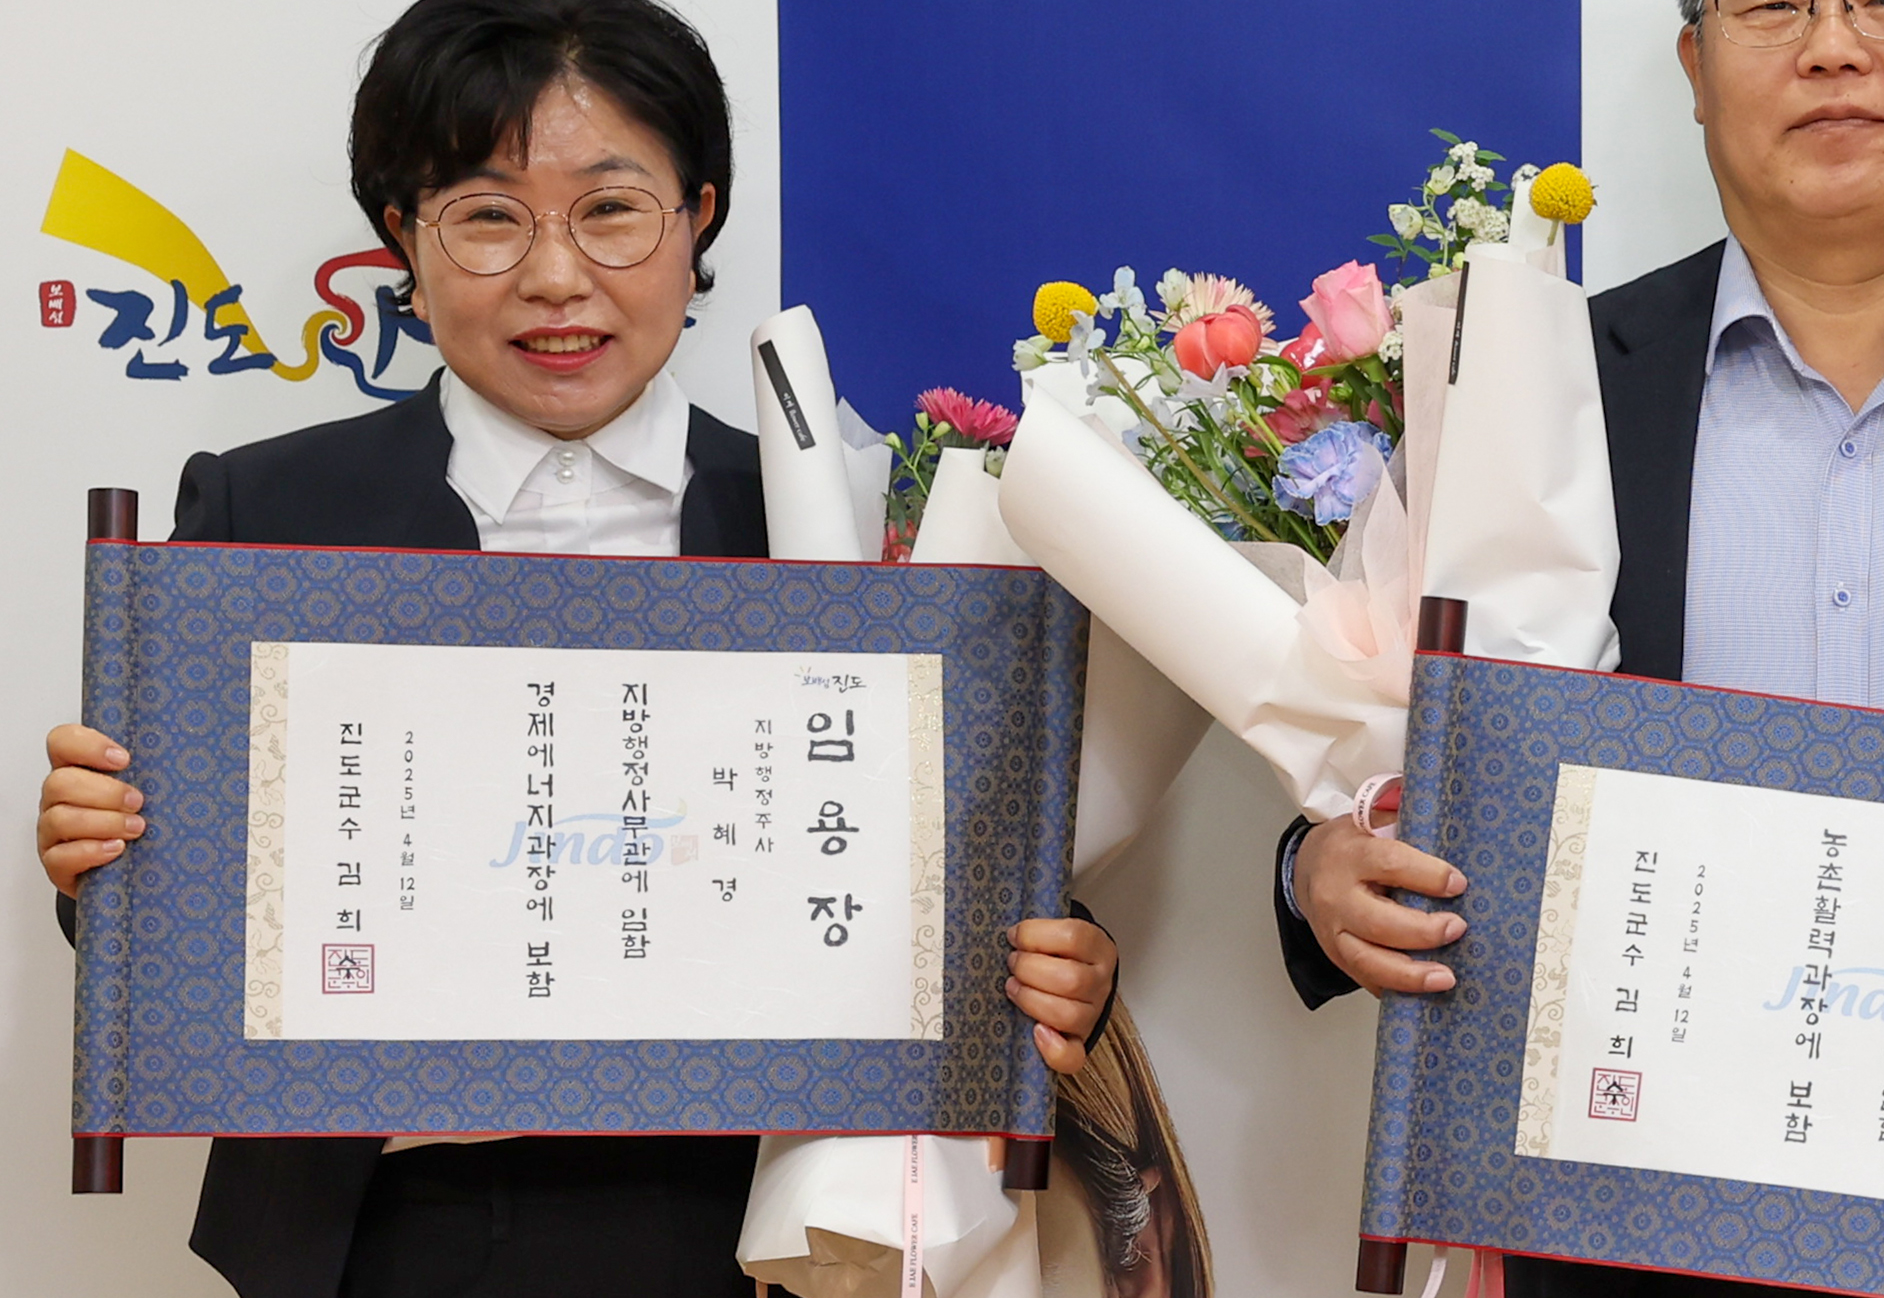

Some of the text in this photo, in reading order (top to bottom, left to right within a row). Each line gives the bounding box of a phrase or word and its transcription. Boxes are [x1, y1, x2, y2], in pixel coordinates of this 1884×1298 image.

[85, 278, 278, 382] 진도
[832, 674, 868, 694] 진도
[338, 722, 363, 841] 진도군수
[399, 730, 415, 911] 2025년 4월 12일
[526, 681, 557, 999] 경제에너지과장에 보함
[621, 682, 652, 960] 지방행정사무관에 임함
[754, 719, 774, 853] 지방행정주사
[1621, 850, 1658, 967] 진도군수
[1671, 864, 1706, 1042] 2025년 4월 12일
[1784, 828, 1848, 1144] 농촌활력과장에 보함
[910, 1234, 918, 1266] FLOWER
[911, 1213, 919, 1233] CAFE
